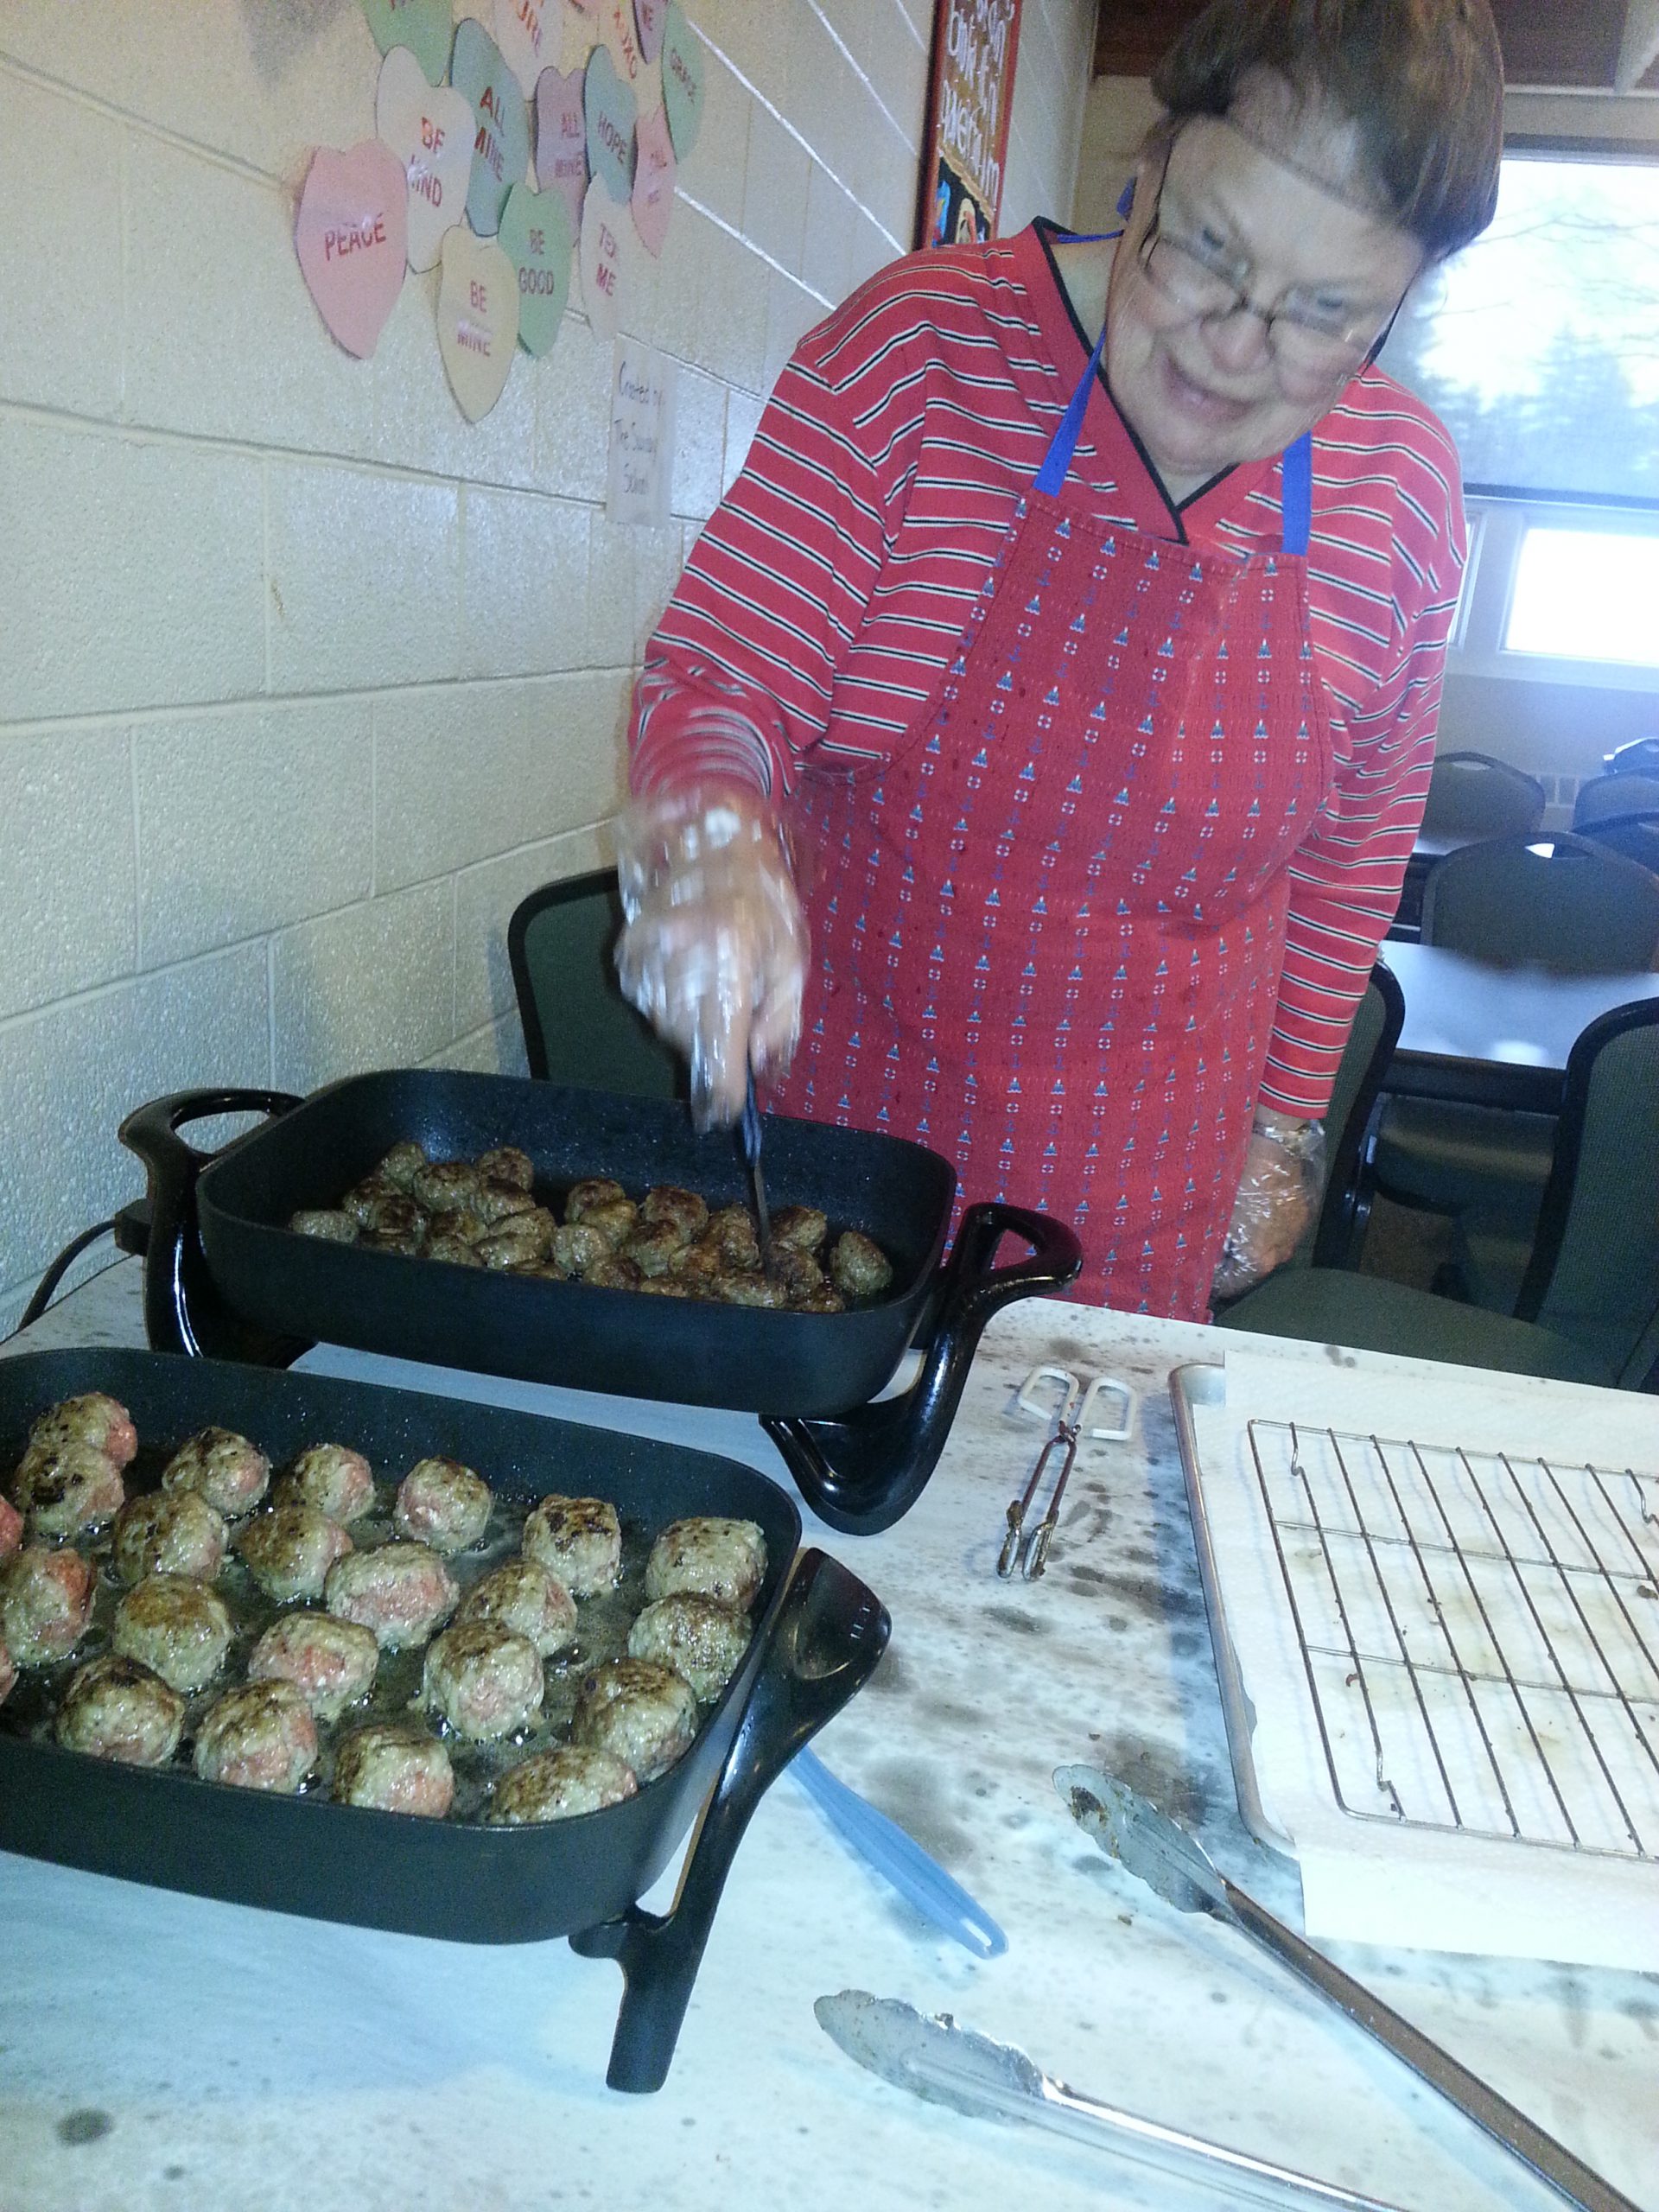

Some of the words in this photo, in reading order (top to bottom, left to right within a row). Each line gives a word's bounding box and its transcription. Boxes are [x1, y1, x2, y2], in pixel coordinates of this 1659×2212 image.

[480, 86, 505, 137] ALL
[420, 116, 445, 154] BE
[598, 111, 627, 164] HOPE
[474, 126, 504, 182] MINE
[529, 228, 545, 256] BE
[470, 279, 487, 314] BE
[518, 266, 555, 295] GOOD
[596, 262, 617, 296] ME
